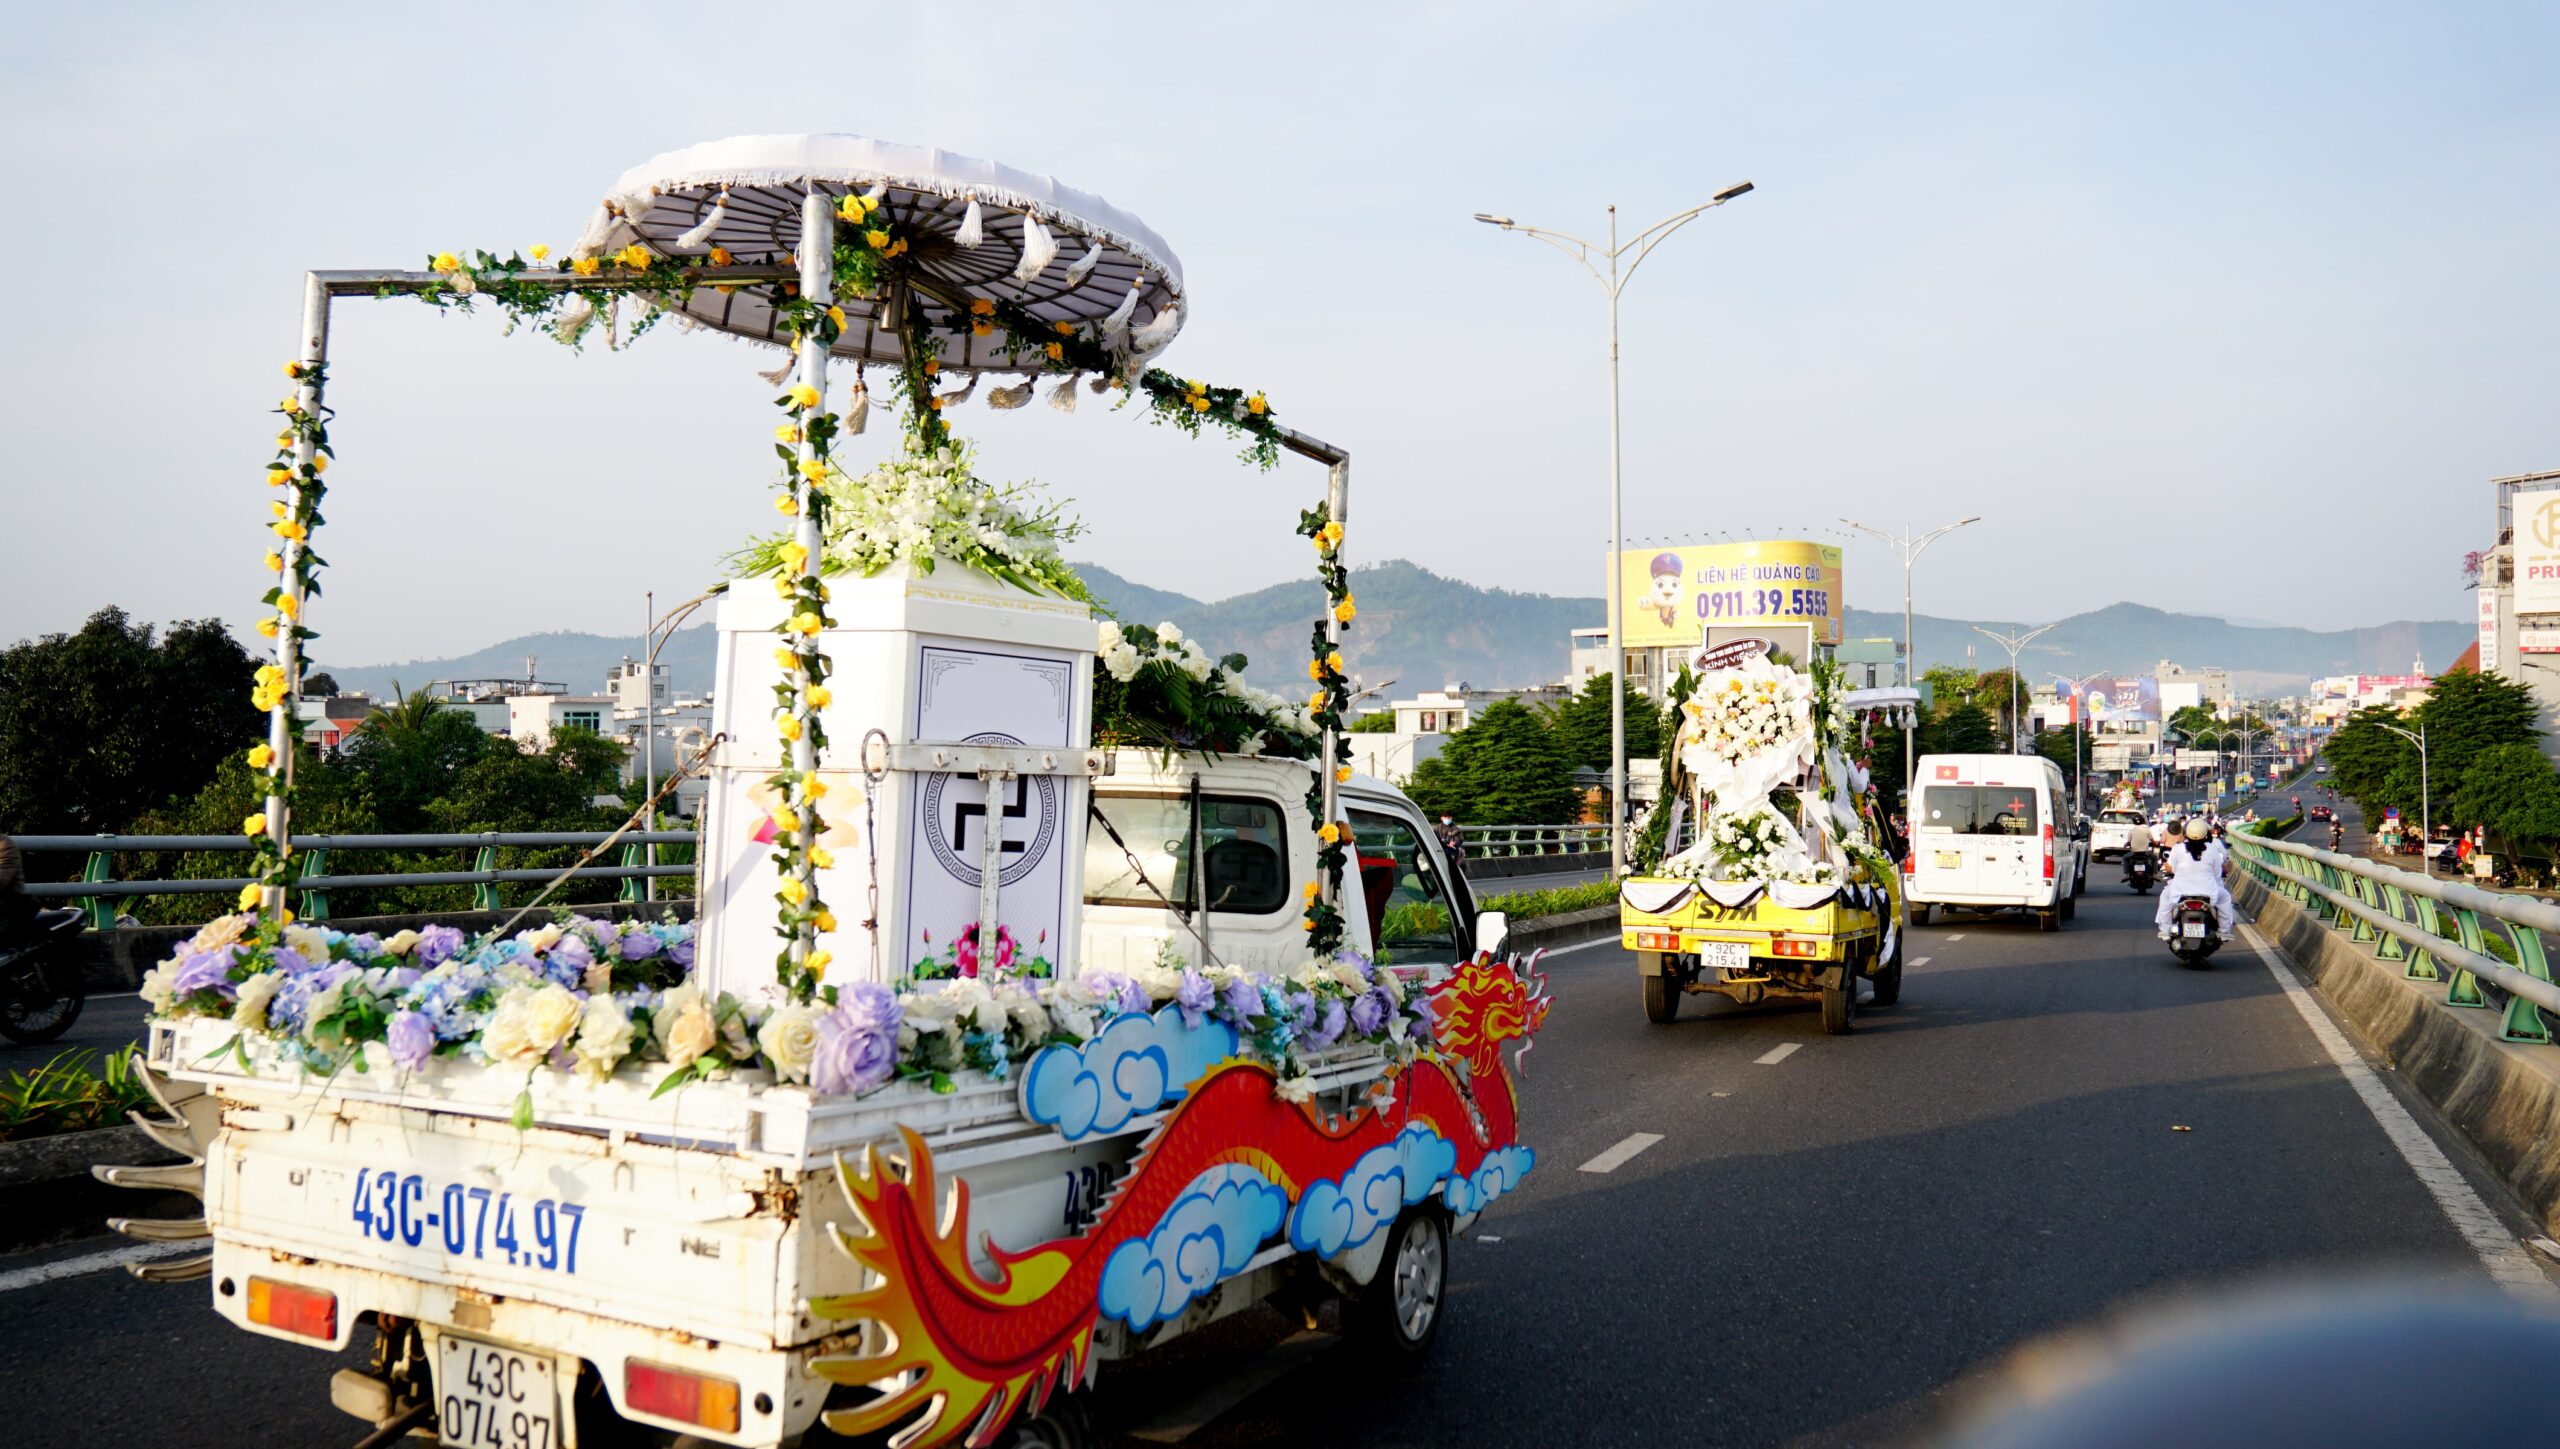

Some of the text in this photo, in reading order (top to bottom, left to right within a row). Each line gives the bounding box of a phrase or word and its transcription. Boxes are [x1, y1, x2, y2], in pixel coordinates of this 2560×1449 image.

[1697, 566, 1725, 584] LIÊN
[1731, 564, 1747, 585] HỆ
[1753, 562, 1801, 581] QUẢNG
[1696, 589, 1828, 619] 0911.39.5555
[1696, 900, 1757, 923] SYM
[1707, 955, 1743, 967] 215.41
[1715, 944, 1736, 955] 92C
[353, 1167, 586, 1274] 43C-074.97
[467, 1347, 526, 1404] 43C
